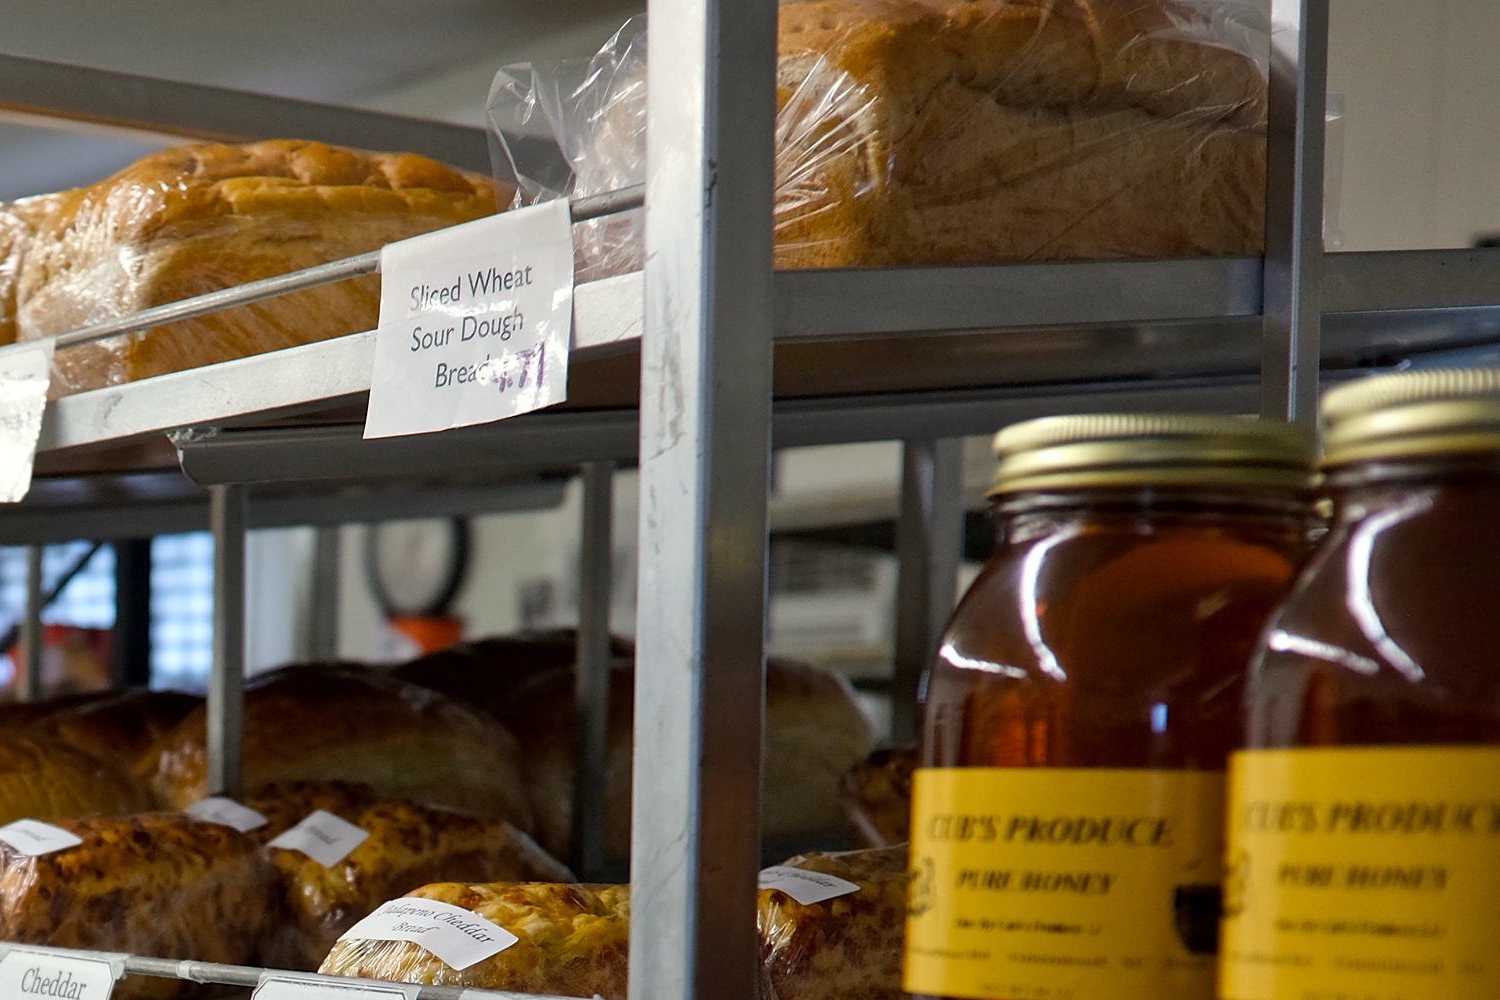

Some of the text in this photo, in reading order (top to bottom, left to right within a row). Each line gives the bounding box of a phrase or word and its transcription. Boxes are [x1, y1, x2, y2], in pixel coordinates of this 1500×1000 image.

[409, 265, 533, 312] Sliced Wheat
[410, 307, 524, 352] Sour Dough
[1004, 814, 1175, 848] PRODUCE
[957, 869, 1115, 896] PURE HONEY
[391, 922, 441, 935] Bread
[433, 911, 495, 945] Cheddar
[20, 968, 87, 1000] Cheddar
